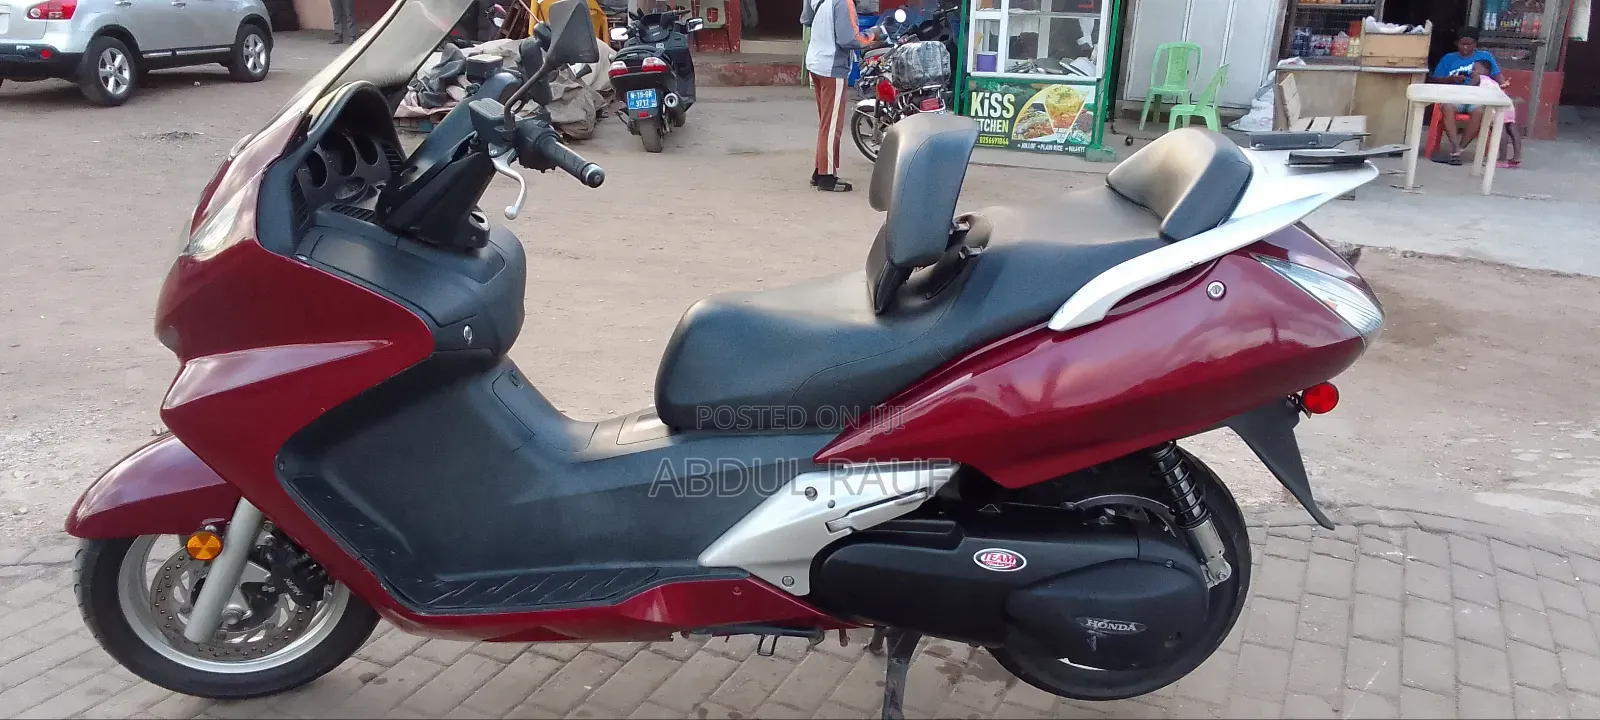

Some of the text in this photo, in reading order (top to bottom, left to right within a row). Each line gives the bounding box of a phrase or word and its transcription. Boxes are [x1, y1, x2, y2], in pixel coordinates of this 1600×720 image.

[974, 118, 1009, 133] TCHEN
[983, 552, 1016, 564] TEAM
[1085, 618, 1137, 632] HONDA
